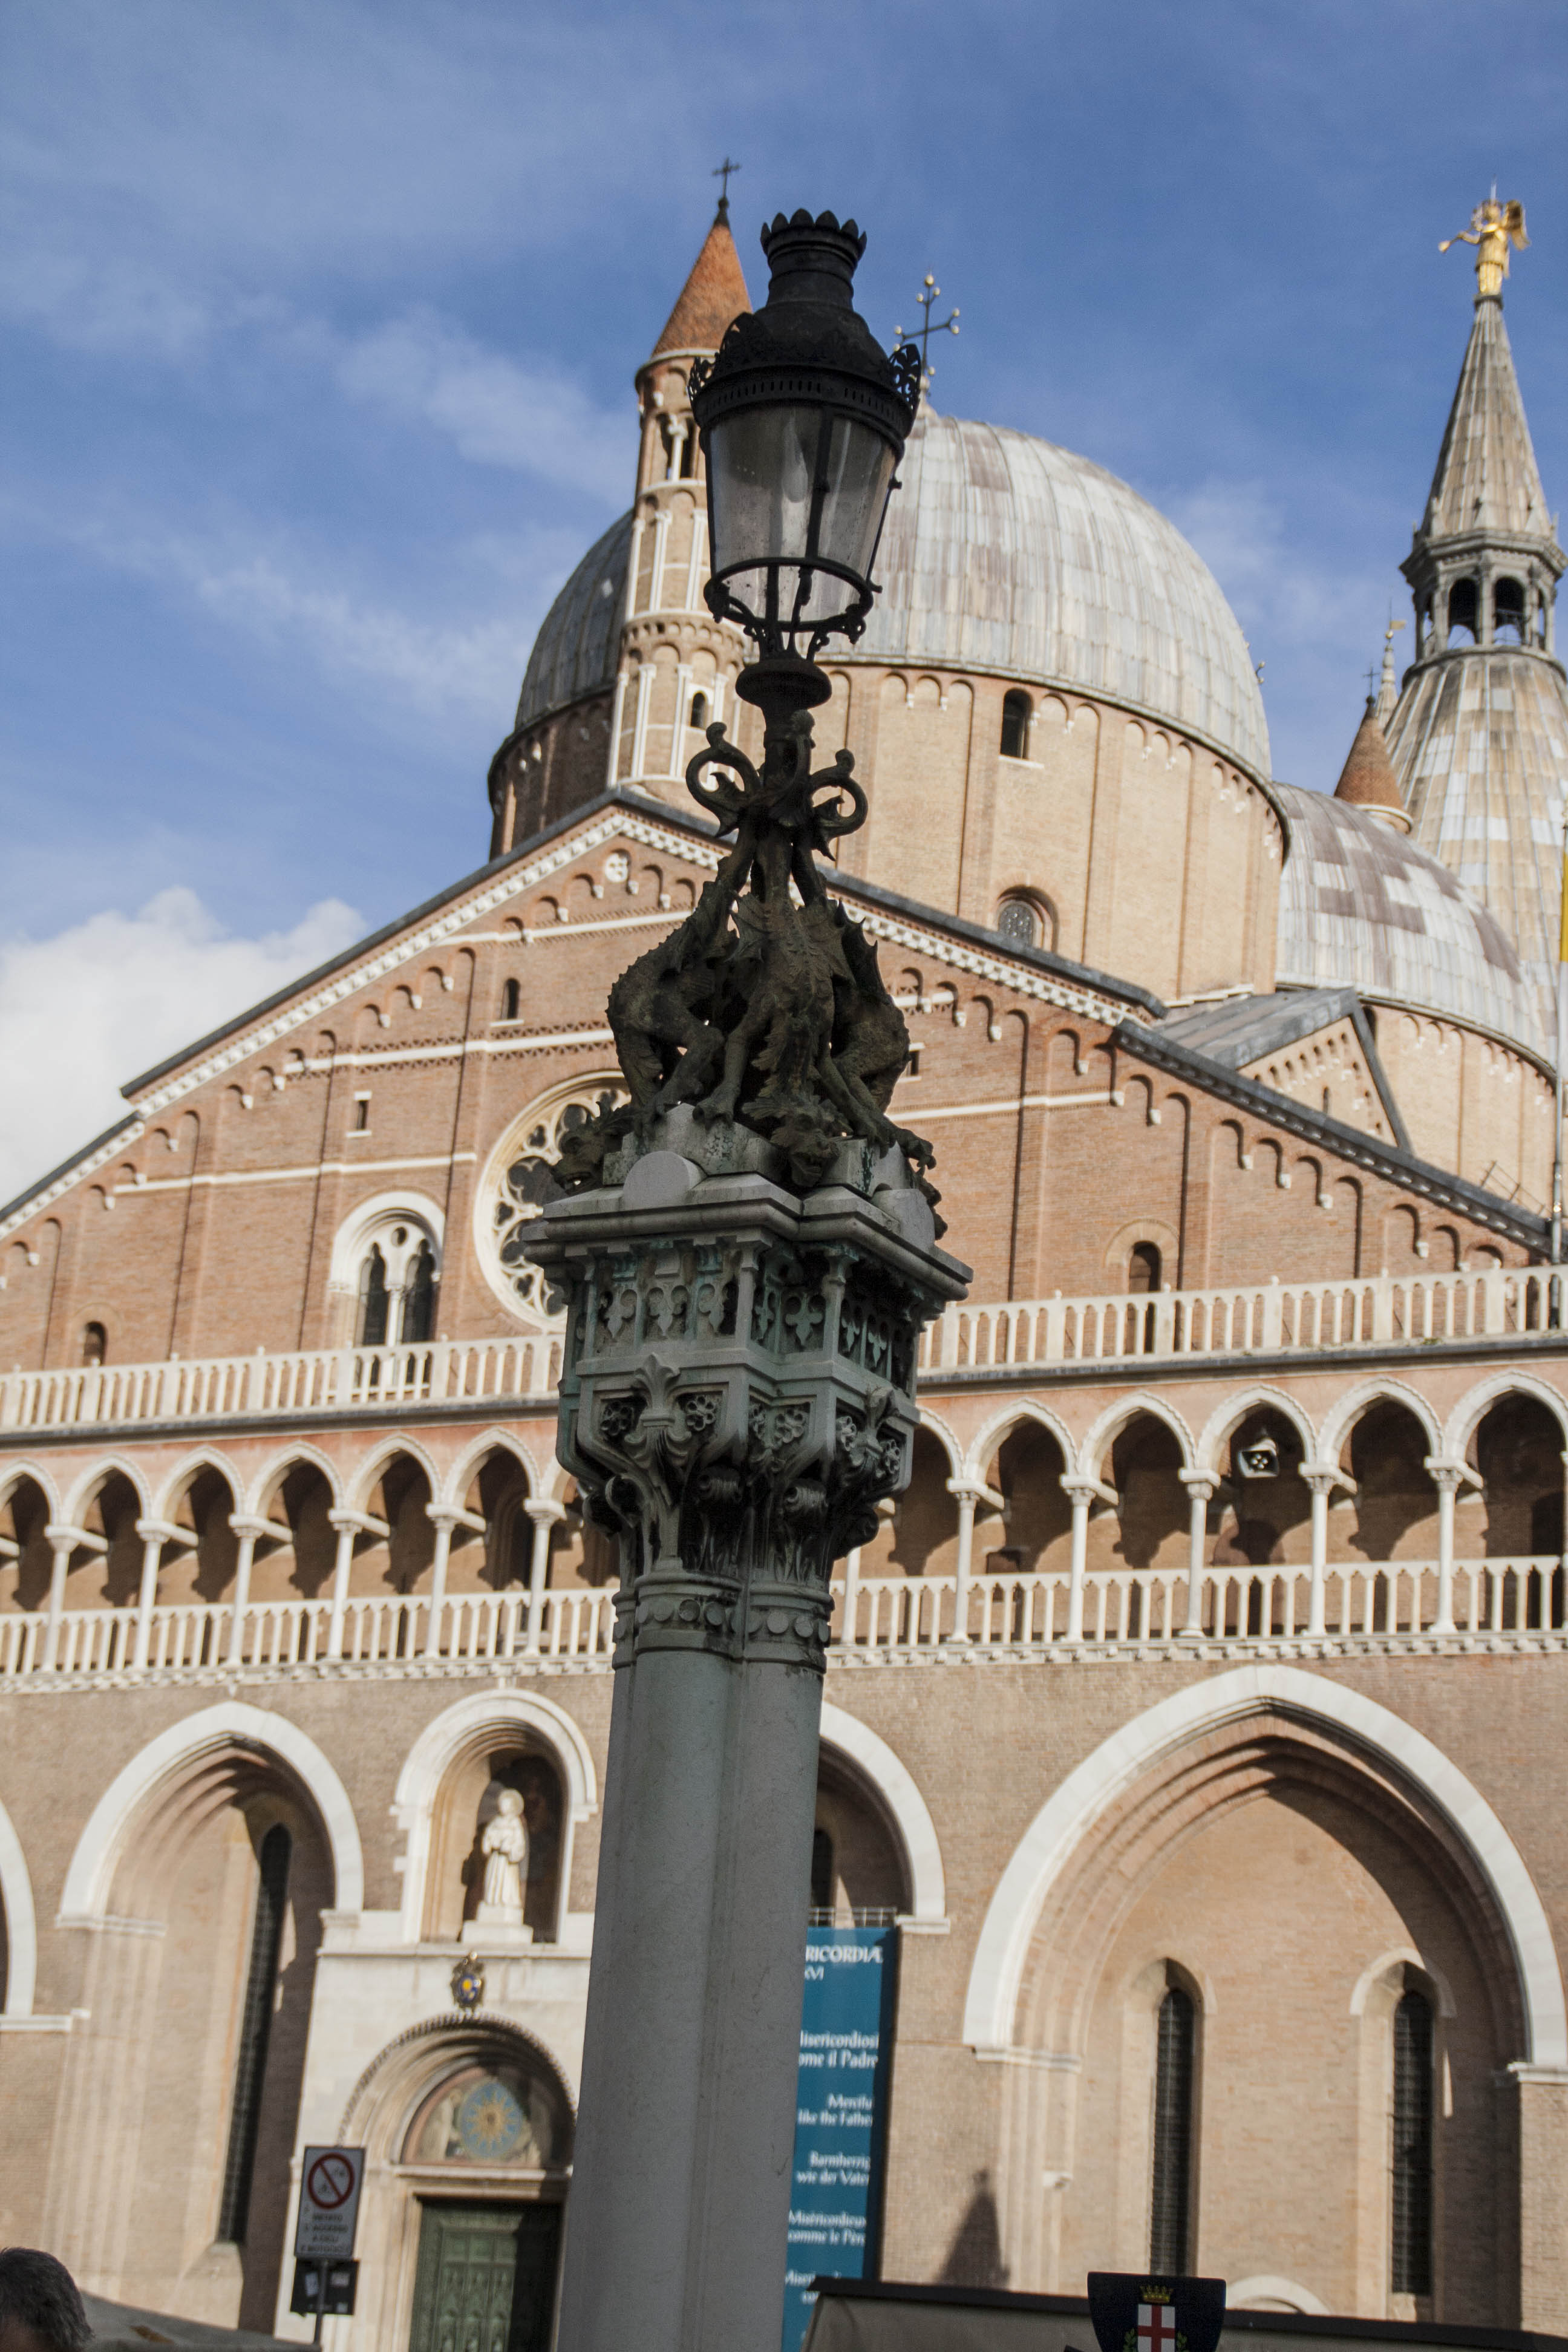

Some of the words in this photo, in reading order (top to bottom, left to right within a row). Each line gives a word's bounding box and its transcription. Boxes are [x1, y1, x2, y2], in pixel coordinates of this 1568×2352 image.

[806, 1945, 884, 1963] RICORDIA
[800, 2030, 879, 2049] isericordiosi
[799, 2053, 824, 2066] ome
[841, 2049, 878, 2068] Padre
[827, 2093, 872, 2111] Mercifu
[798, 2109, 817, 2125] like
[820, 2109, 837, 2125] the
